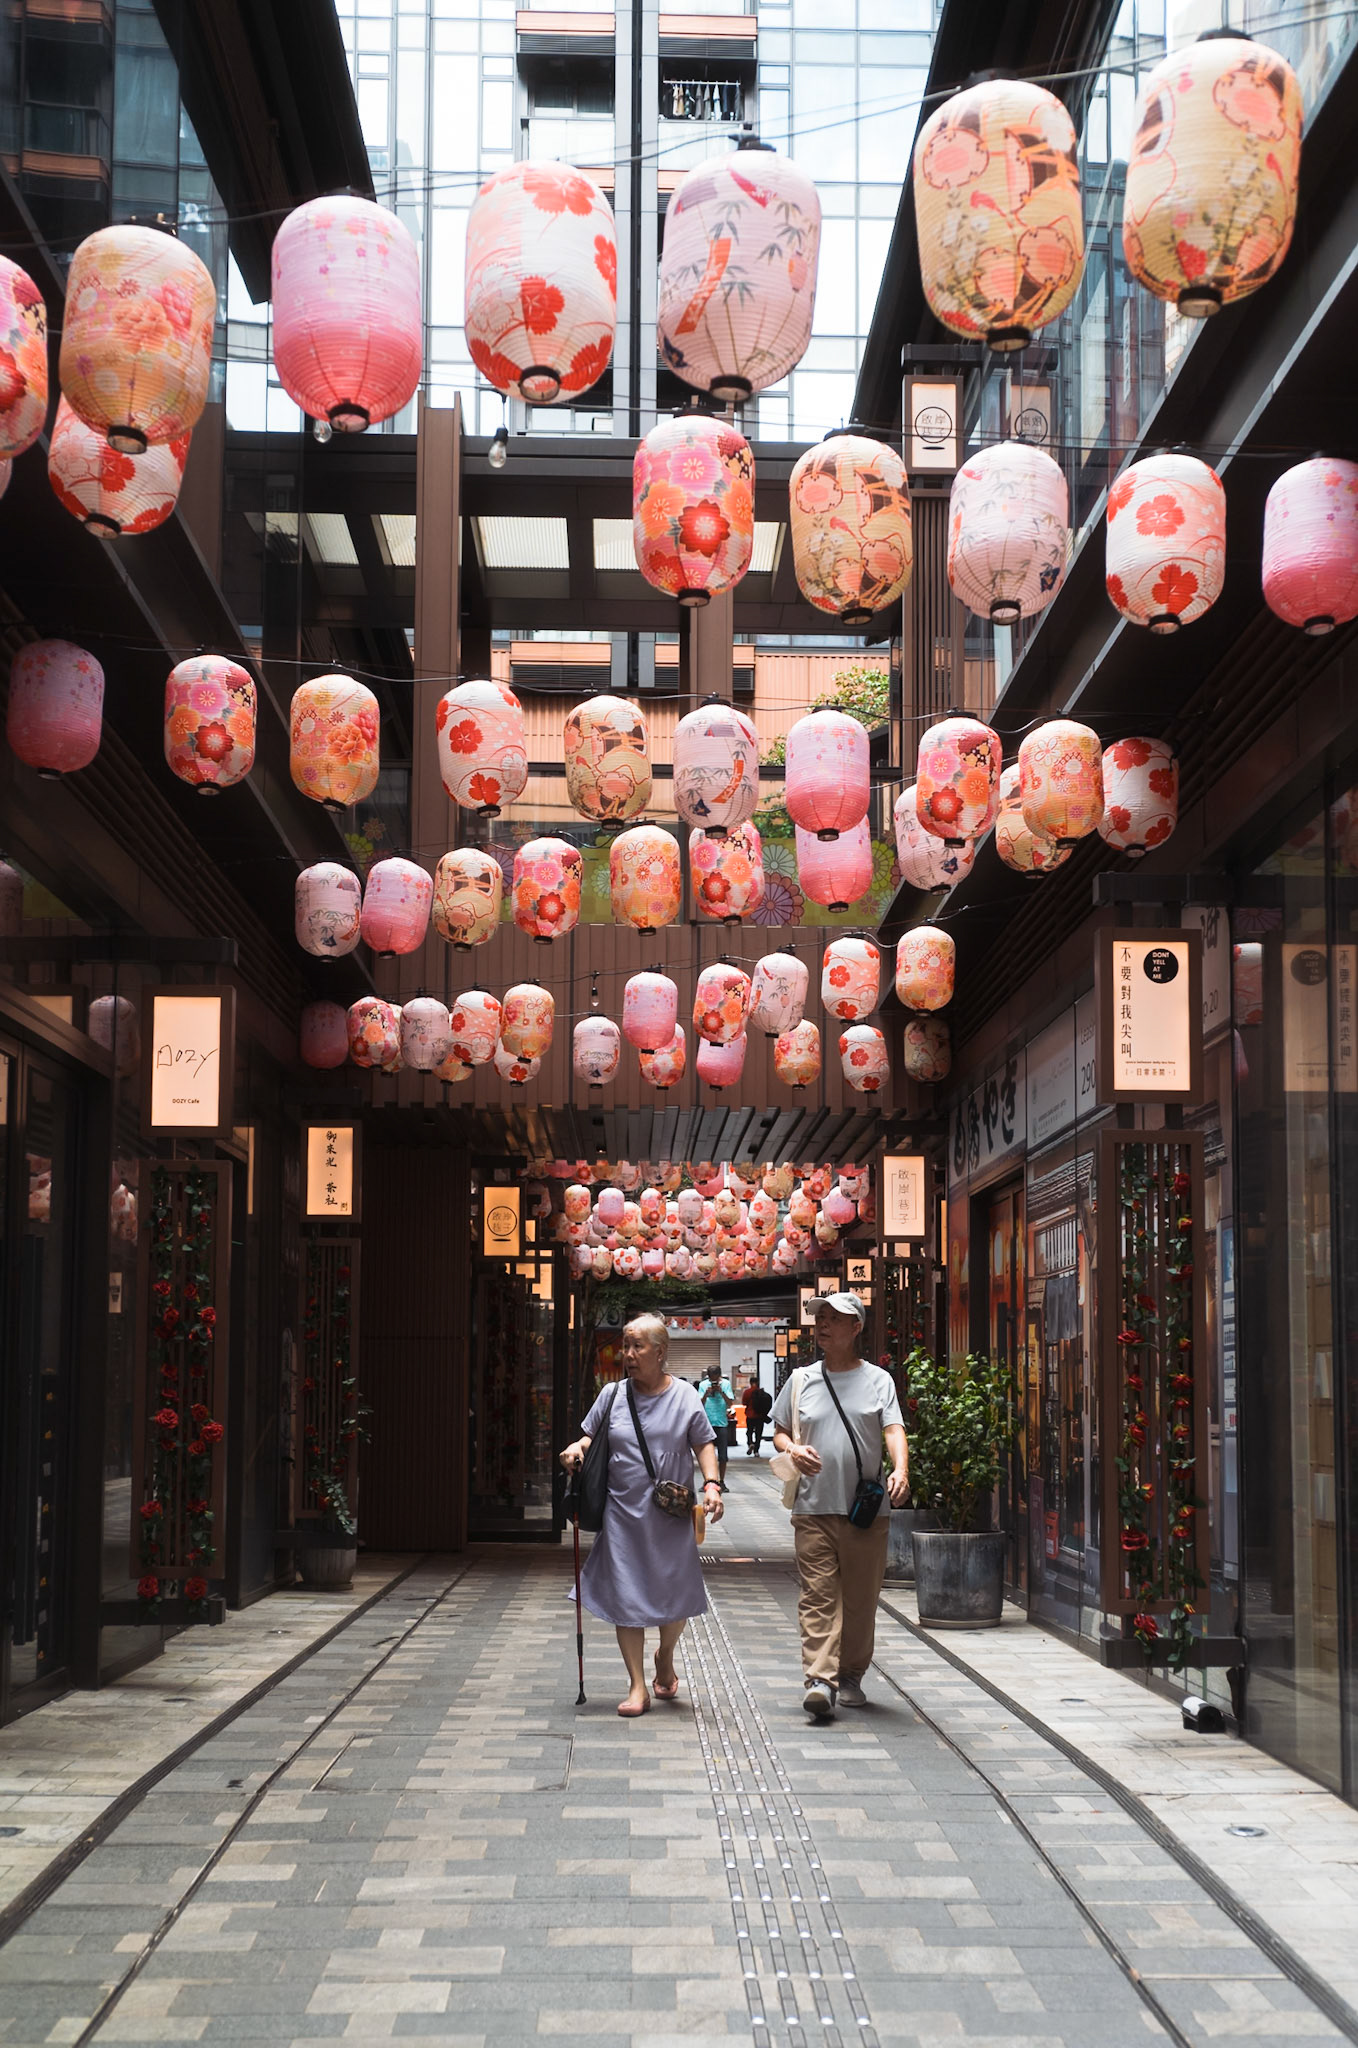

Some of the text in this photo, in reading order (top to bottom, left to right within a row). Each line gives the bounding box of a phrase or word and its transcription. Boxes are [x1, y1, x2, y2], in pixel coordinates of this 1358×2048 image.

[1120, 947, 1132, 1058] 不要對我尖叫
